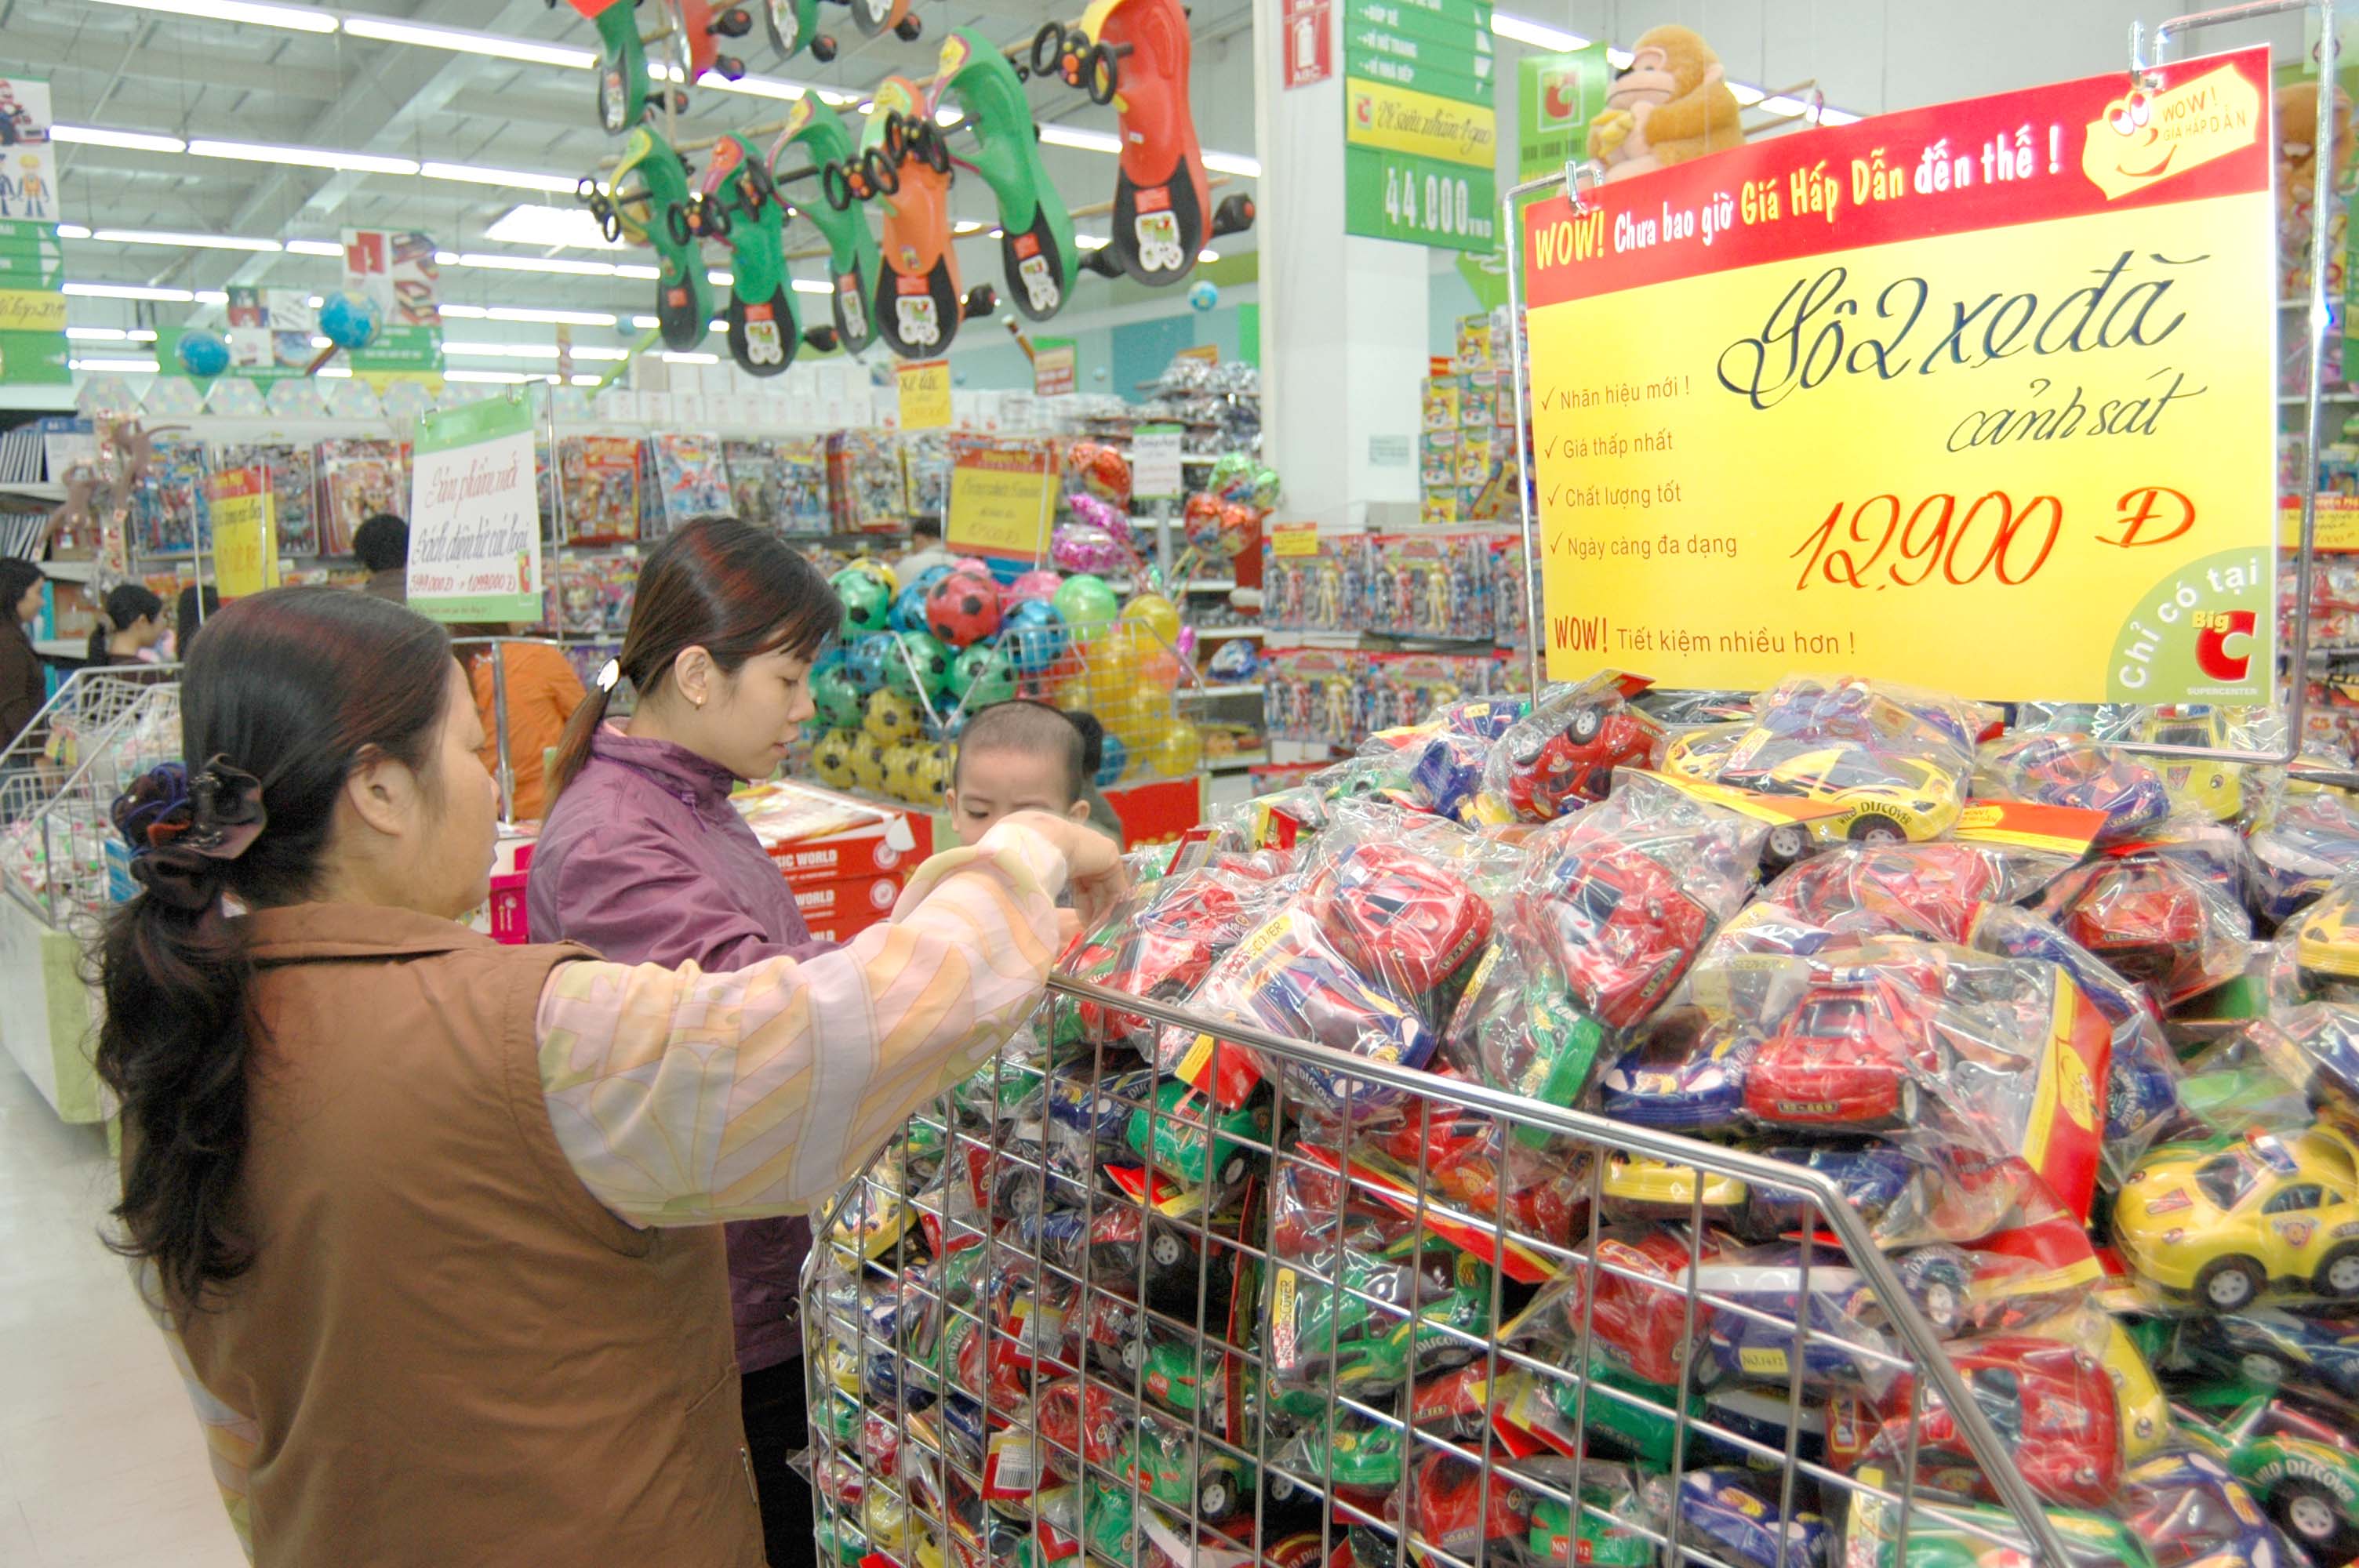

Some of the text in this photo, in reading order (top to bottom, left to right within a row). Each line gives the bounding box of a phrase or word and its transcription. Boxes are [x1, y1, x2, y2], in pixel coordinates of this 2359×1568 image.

[1535, 211, 1605, 270] WOW!
[1614, 209, 1660, 253] Chưa
[1662, 201, 1695, 241] bao
[1701, 191, 1735, 246] giờ
[1741, 173, 1780, 226] Giá
[1790, 159, 1839, 223] Hấp
[1851, 147, 1905, 207] Dẫn
[1914, 138, 1971, 195] đến
[1981, 123, 2035, 185] thế
[1560, 389, 1601, 409] Nhãn
[1605, 383, 1640, 408] hiệu
[1647, 378, 1679, 399] mới
[1946, 366, 2209, 453] cảnh sát
[1563, 428, 1674, 458] Giá thấp nhất
[1565, 479, 1682, 509] Chất lượng tốt
[2092, 486, 2197, 548] Đ
[1568, 533, 1738, 561] Ngày càng đa dạng
[2118, 557, 2258, 689] Chỉ có tại
[2191, 609, 2230, 633] Big
[1554, 616, 1608, 654] WOW!
[1616, 625, 1652, 652] Tiết
[1659, 630, 1711, 657] kiệm
[1719, 625, 1786, 654] nhiều
[1794, 631, 1840, 654] hơn
[1860, 800, 1914, 826] DISCOVER
[795, 848, 838, 867] WORLD
